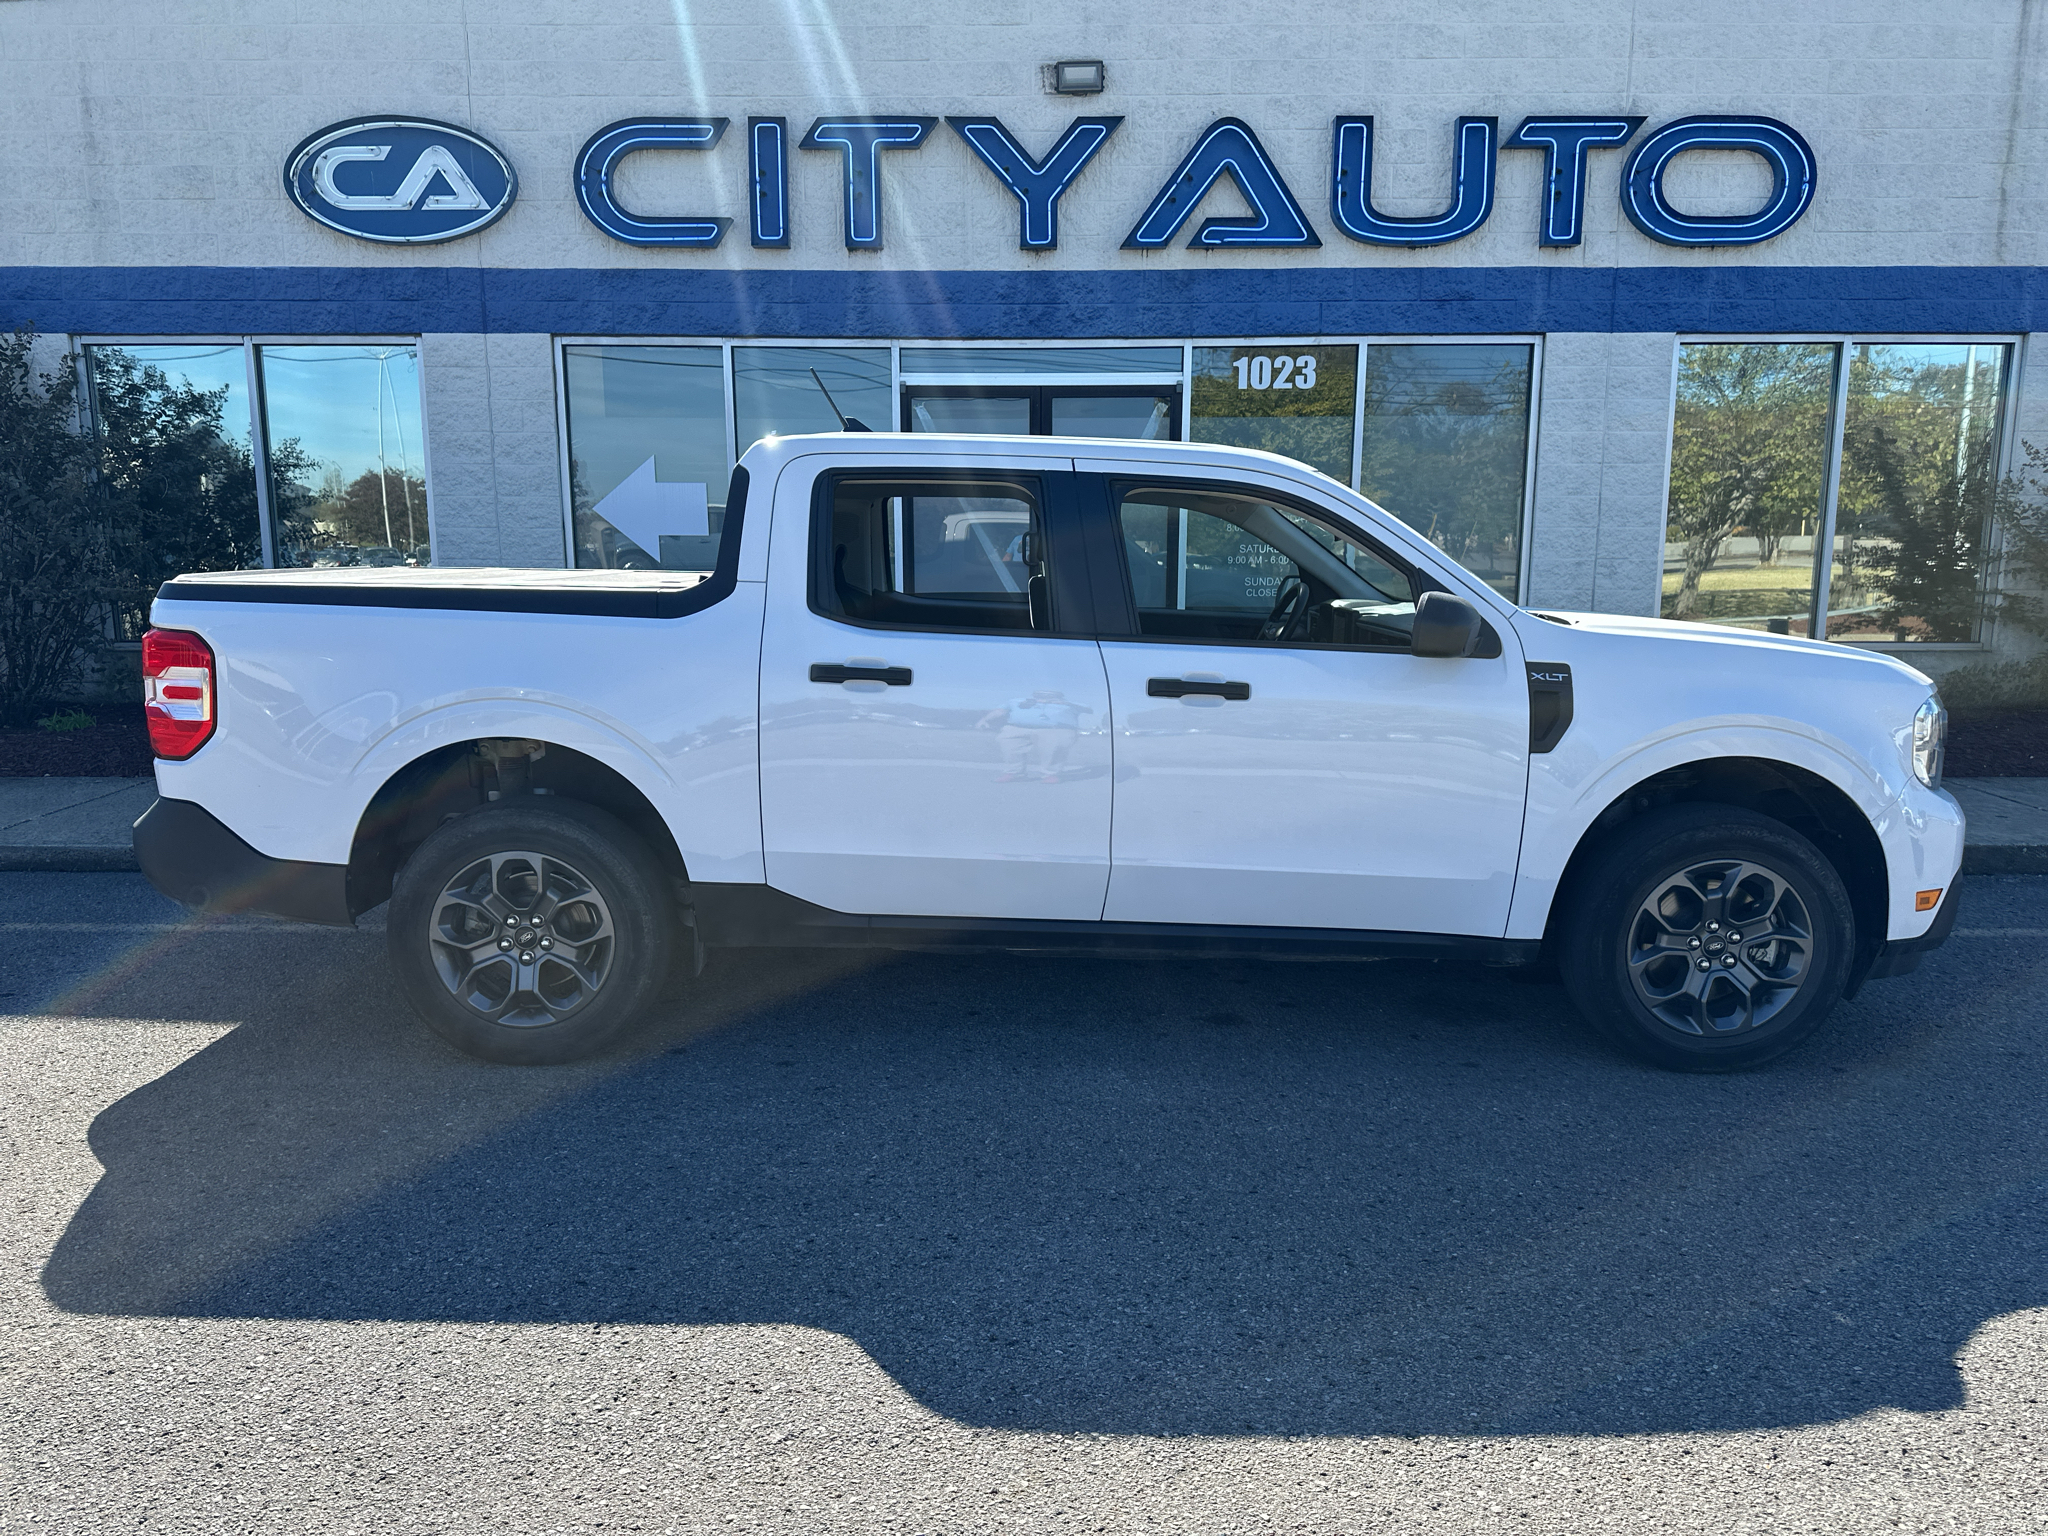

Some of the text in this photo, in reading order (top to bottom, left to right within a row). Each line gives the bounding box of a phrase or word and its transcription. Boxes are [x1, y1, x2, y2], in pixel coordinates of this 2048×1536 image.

[313, 145, 491, 211] CA
[574, 115, 1817, 250] CITY AUTO
[1233, 355, 1317, 390] 1023
[1227, 555, 1246, 565] 9:00
[1248, 555, 1262, 565] AM
[1270, 555, 1289, 565] 6:00
[1531, 672, 1568, 681] XLT
